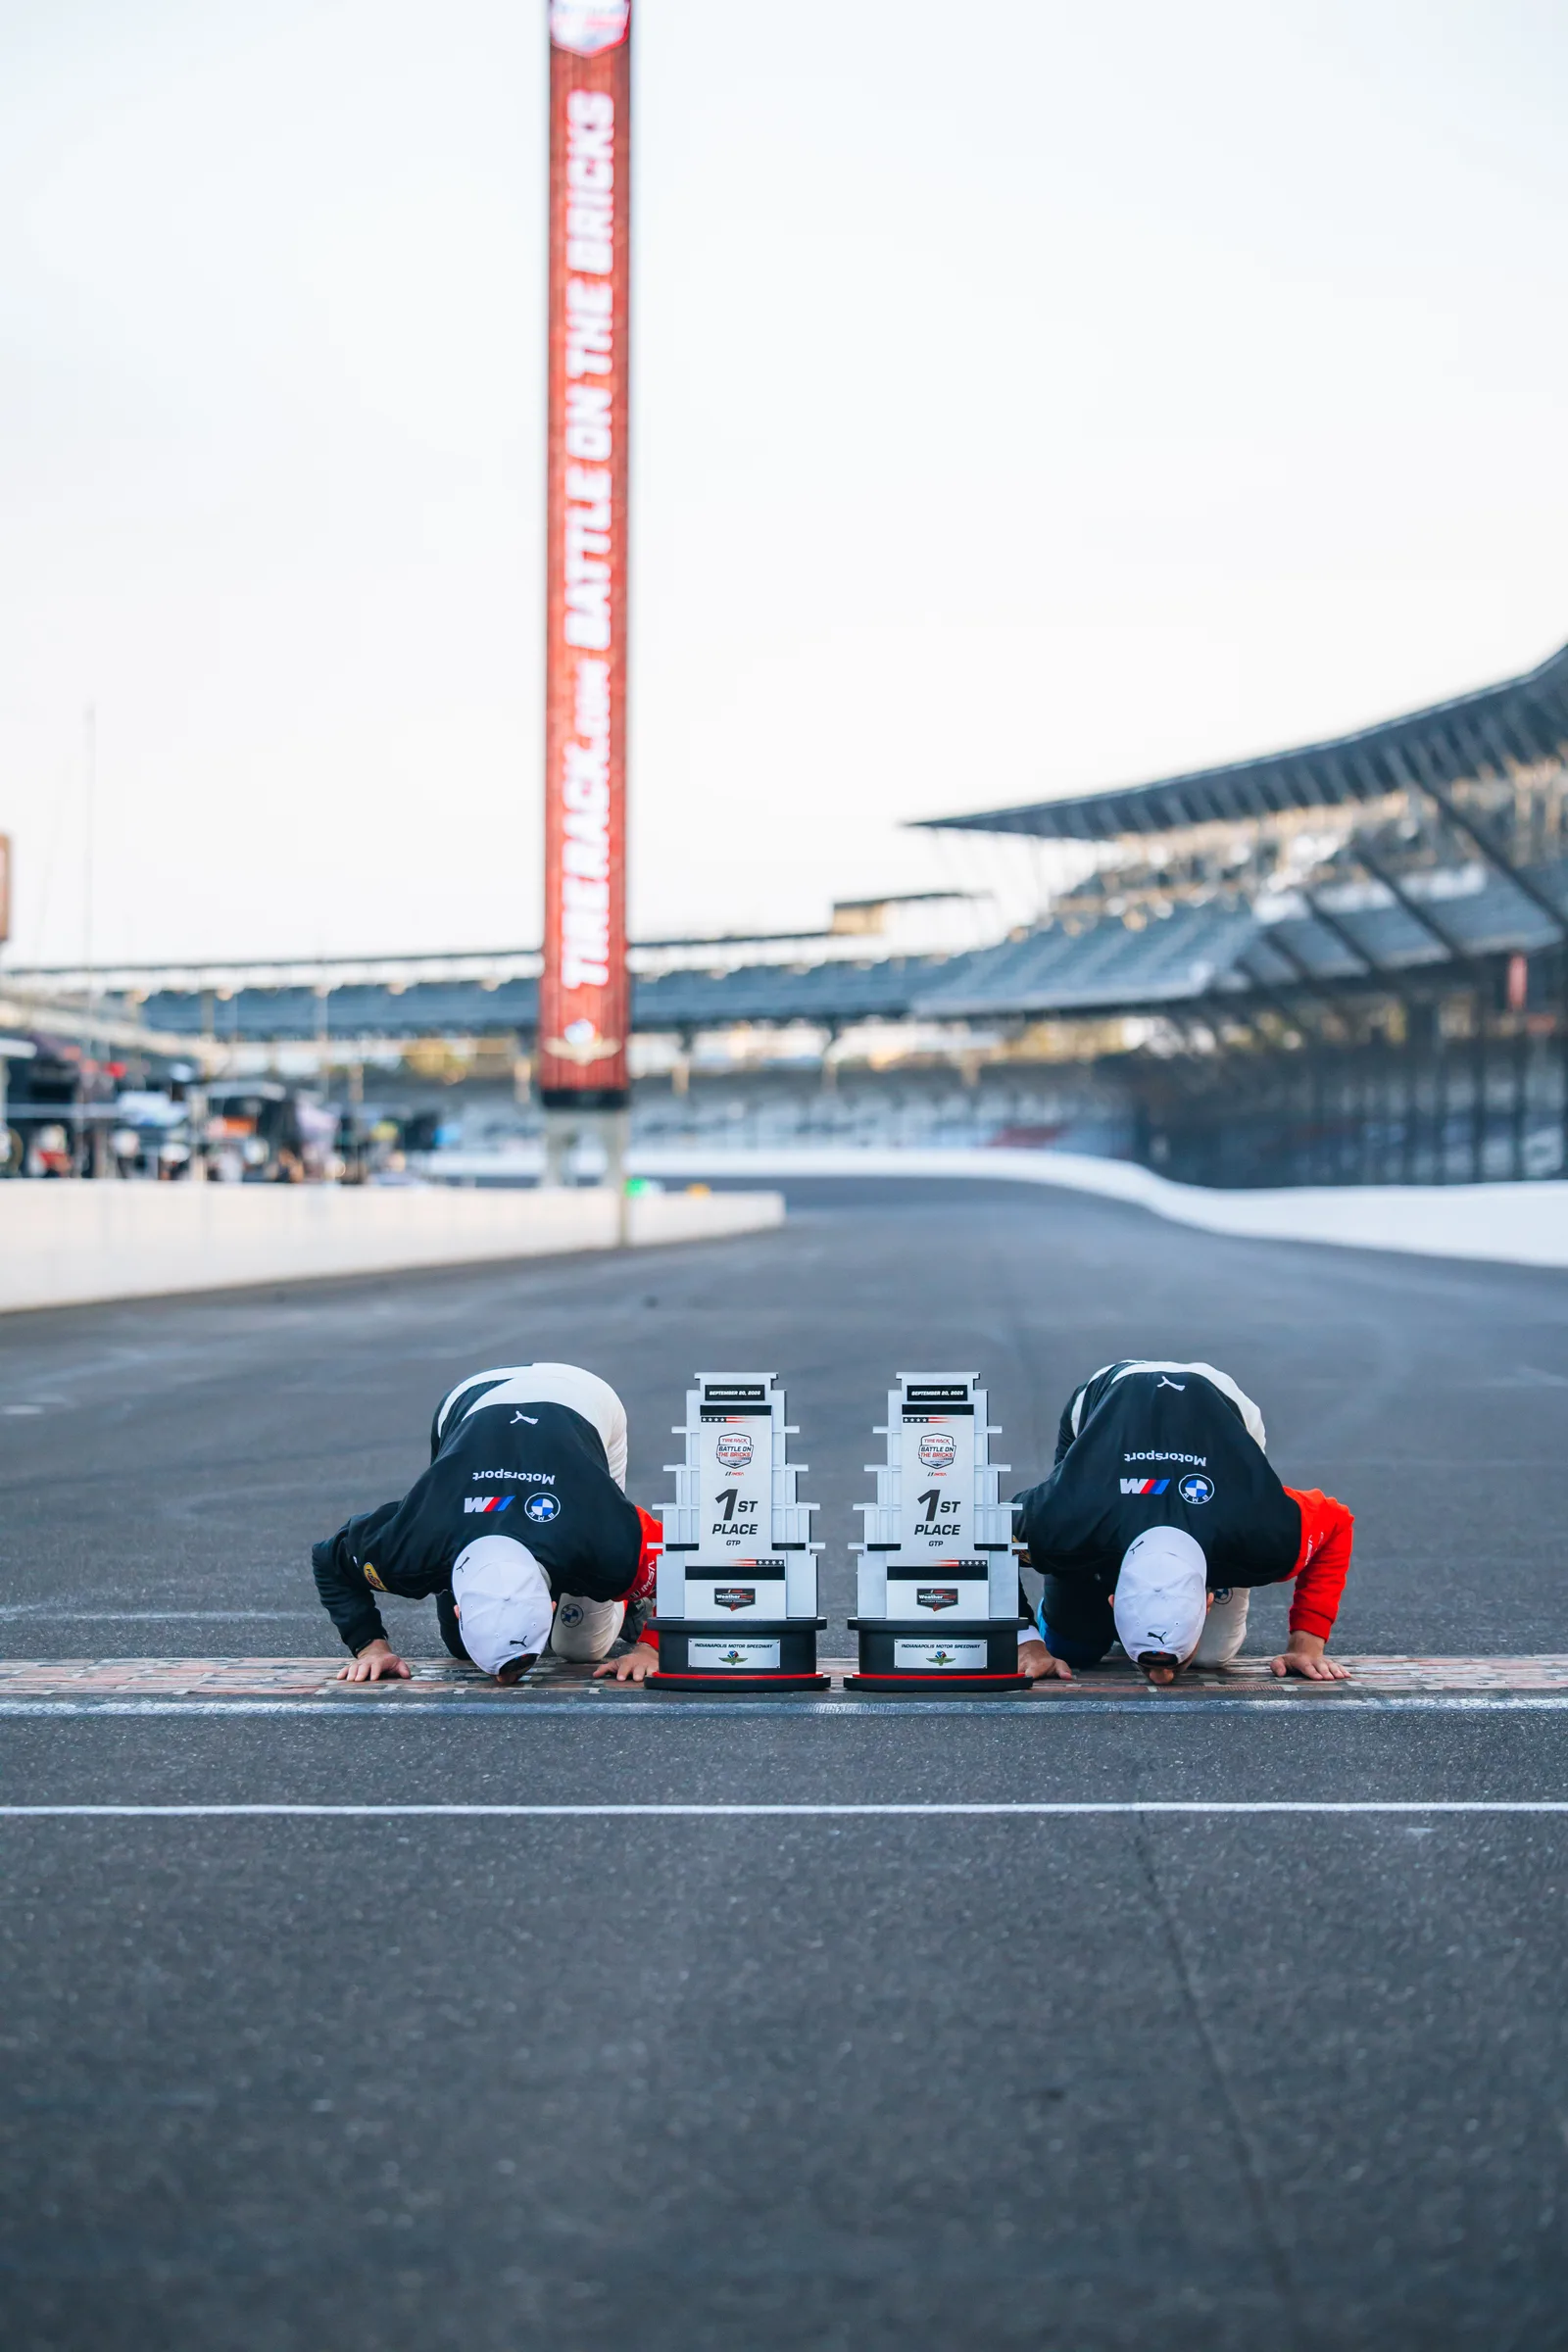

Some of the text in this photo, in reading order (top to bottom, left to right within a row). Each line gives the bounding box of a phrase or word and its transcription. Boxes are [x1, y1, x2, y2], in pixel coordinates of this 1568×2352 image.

[564, 89, 614, 276] BRICKS
[564, 277, 613, 379] THE
[564, 386, 612, 463] ON
[564, 465, 612, 651] BATTLE
[1124, 1449, 1206, 1466] Motorsport
[472, 1468, 556, 1485] Motorsport
[715, 1489, 759, 1521] 1ST
[917, 1490, 960, 1521] 1ST
[711, 1524, 759, 1535] PLACE
[914, 1525, 960, 1535] PLACE
